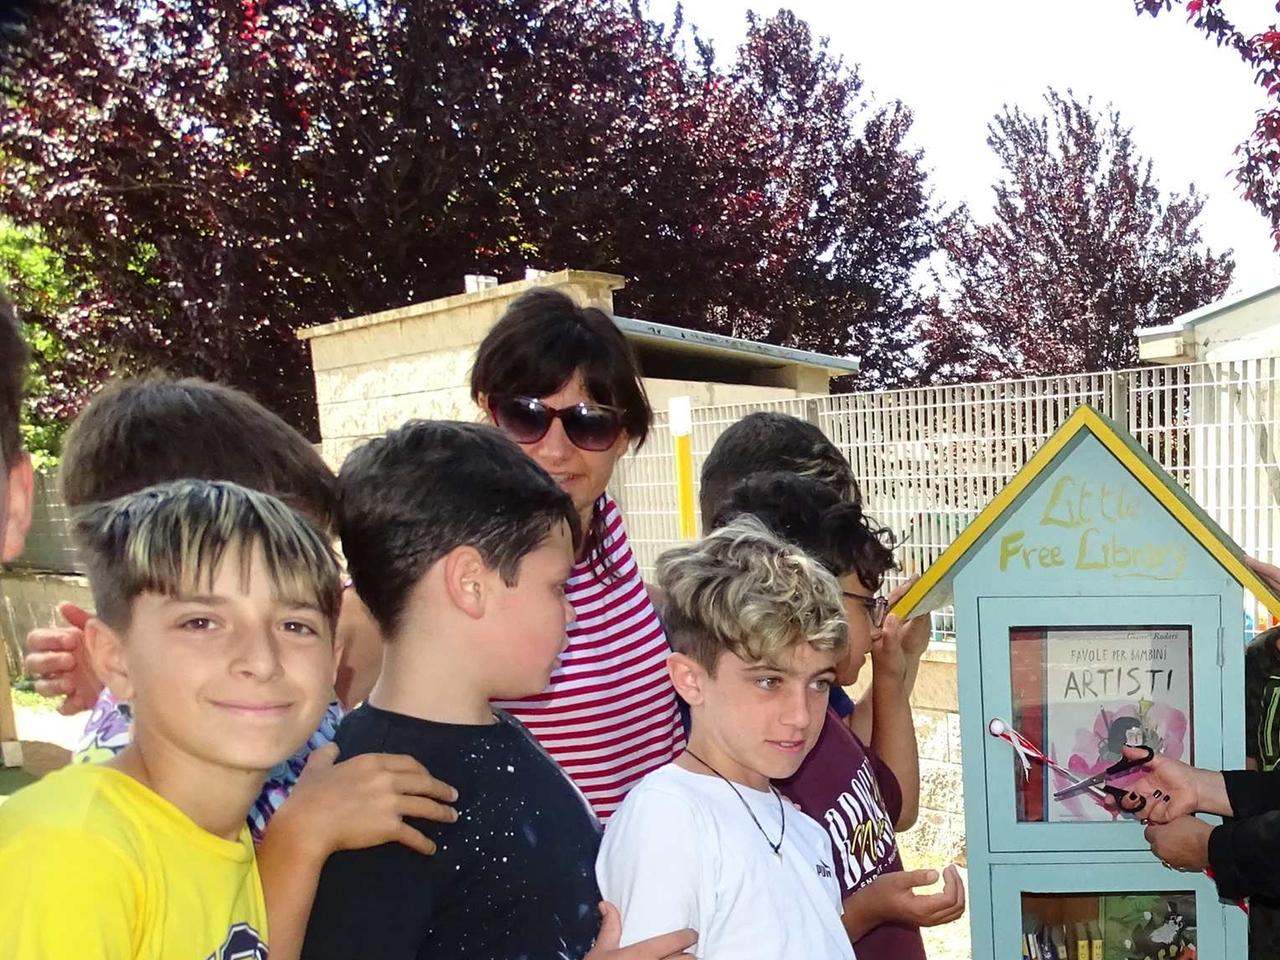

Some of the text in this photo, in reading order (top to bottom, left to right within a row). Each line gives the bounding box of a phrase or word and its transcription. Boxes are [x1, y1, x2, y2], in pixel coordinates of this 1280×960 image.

[1040, 475, 1141, 529] Little
[999, 527, 1188, 580] Free Library
[1071, 648, 1109, 663] FAVOLE
[1112, 649, 1128, 662] PER
[1064, 667, 1174, 699] ARTISTI
